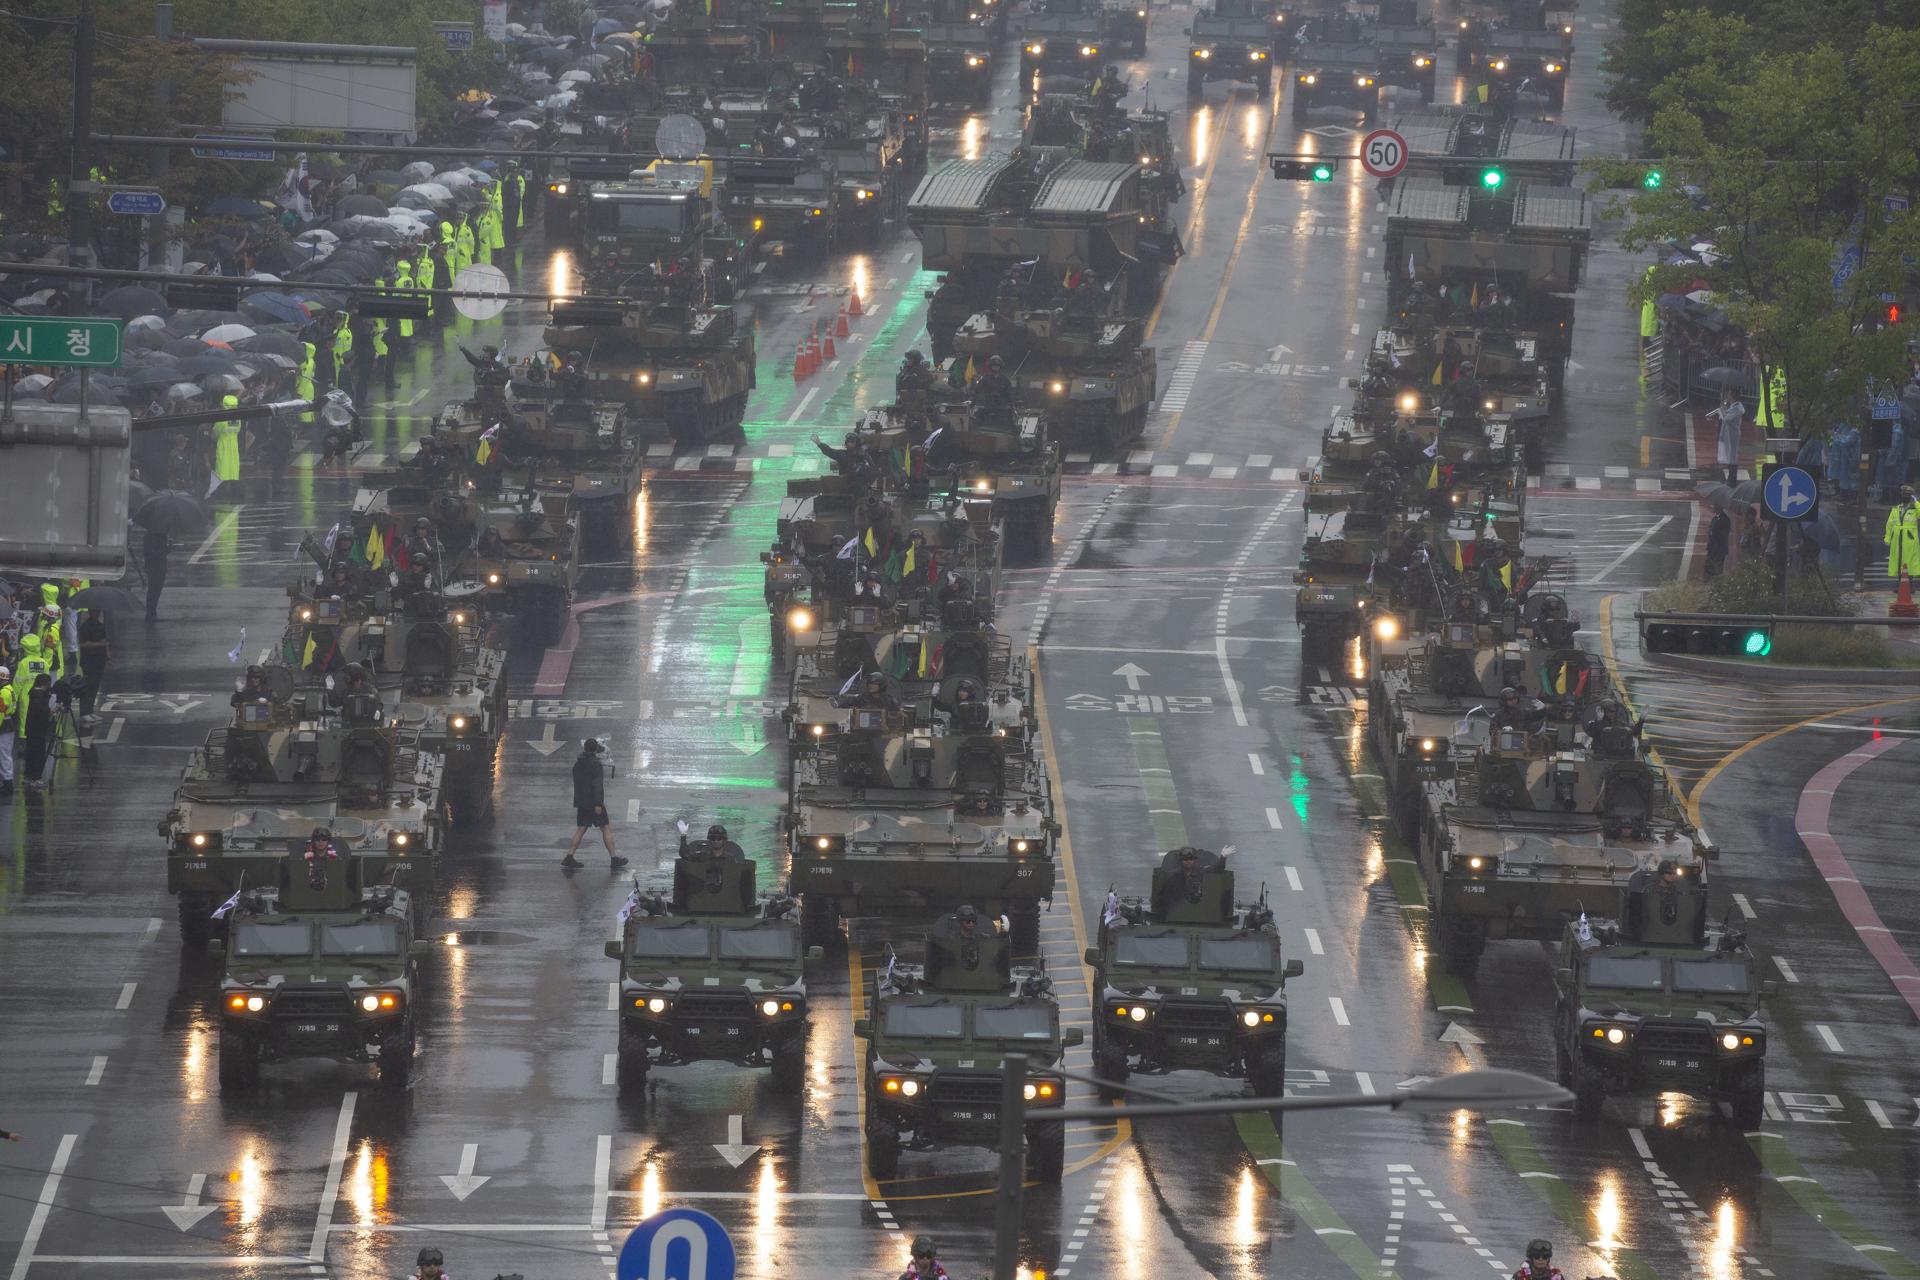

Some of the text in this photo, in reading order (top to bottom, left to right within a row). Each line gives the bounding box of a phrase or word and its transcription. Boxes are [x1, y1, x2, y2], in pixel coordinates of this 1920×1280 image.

[1370, 142, 1397, 166] 50
[1064, 693, 1214, 714] 숭례문
[455, 743, 472, 751] 310
[1017, 869, 1034, 878] 307
[1208, 1037, 1220, 1045] 304
[983, 1112, 996, 1120] 301
